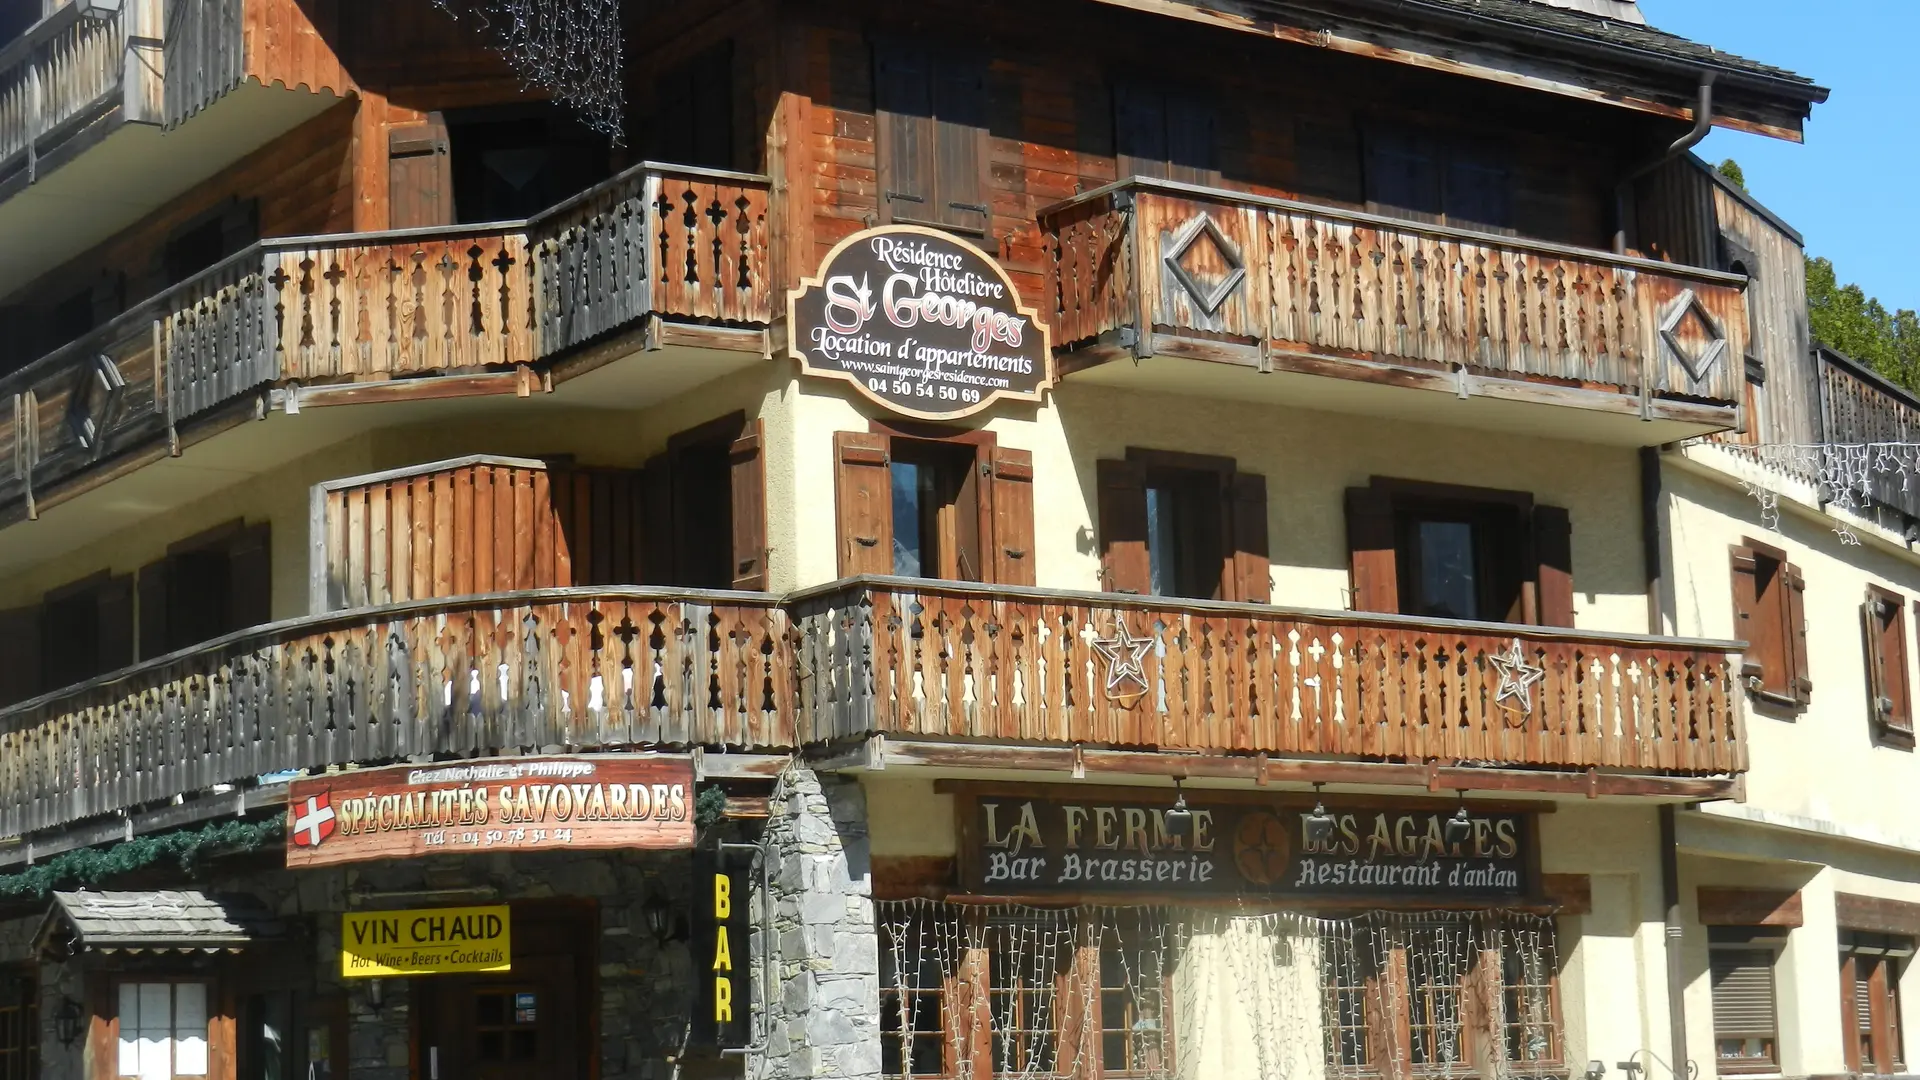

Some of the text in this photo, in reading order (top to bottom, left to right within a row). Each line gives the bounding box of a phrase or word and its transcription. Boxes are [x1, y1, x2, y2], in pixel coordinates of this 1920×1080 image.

[871, 237, 1004, 299] Résidence Hôtelière
[825, 271, 1026, 353] St Georges
[811, 327, 891, 360] Location
[841, 360, 1009, 388] www.saintgeorgesresidence.com
[868, 378, 980, 404] 04 50 54 50 69
[409, 761, 592, 784] Chez Nathalie et Philippe
[341, 782, 686, 836] SPÉCIALITÉS SAVOYARDES
[424, 830, 446, 846] Tél
[463, 831, 480, 846] 04
[486, 831, 503, 846] 50
[509, 827, 525, 844] 78
[532, 829, 547, 843] 31
[555, 828, 572, 843] 24
[983, 801, 1046, 858] LA
[984, 852, 1214, 883] Bar Brasserie
[1295, 858, 1517, 887] Restaurant d'antan
[351, 914, 503, 945] VIN CHAUD
[350, 948, 503, 968] Hot Wine Beers Cocktails
[713, 873, 732, 1022] BAR
